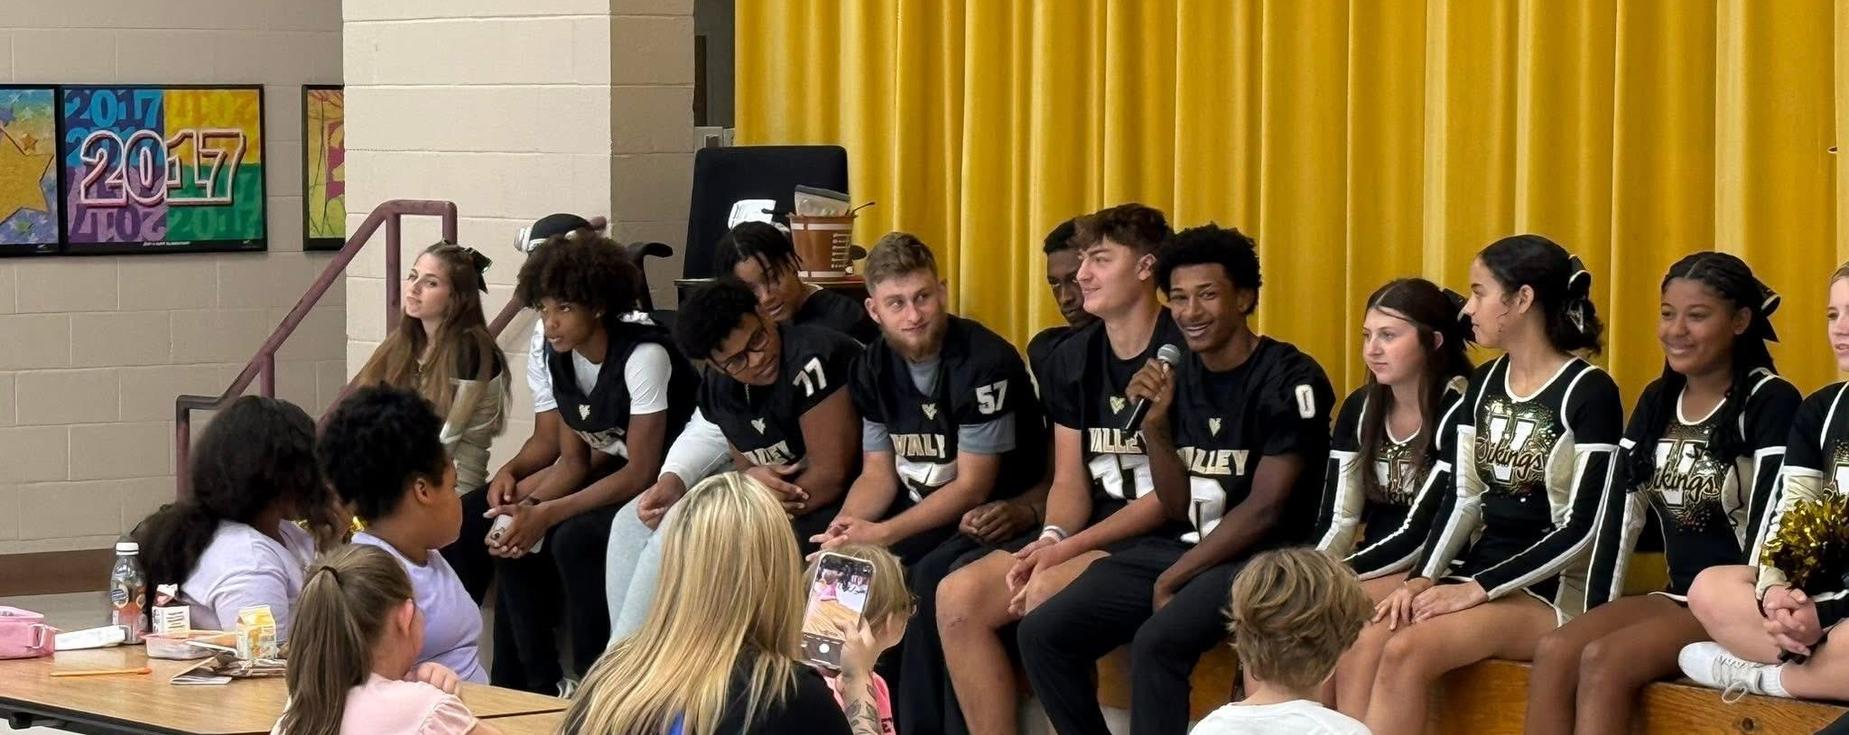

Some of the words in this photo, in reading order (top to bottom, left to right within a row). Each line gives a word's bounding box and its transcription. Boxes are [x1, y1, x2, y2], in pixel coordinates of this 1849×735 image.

[81, 129, 246, 207] 2017
[792, 356, 827, 397] 77
[976, 379, 1008, 415] 57
[1295, 384, 1316, 419] 0
[1176, 446, 1250, 476] ALLEY
[1646, 461, 1720, 503] ikings
